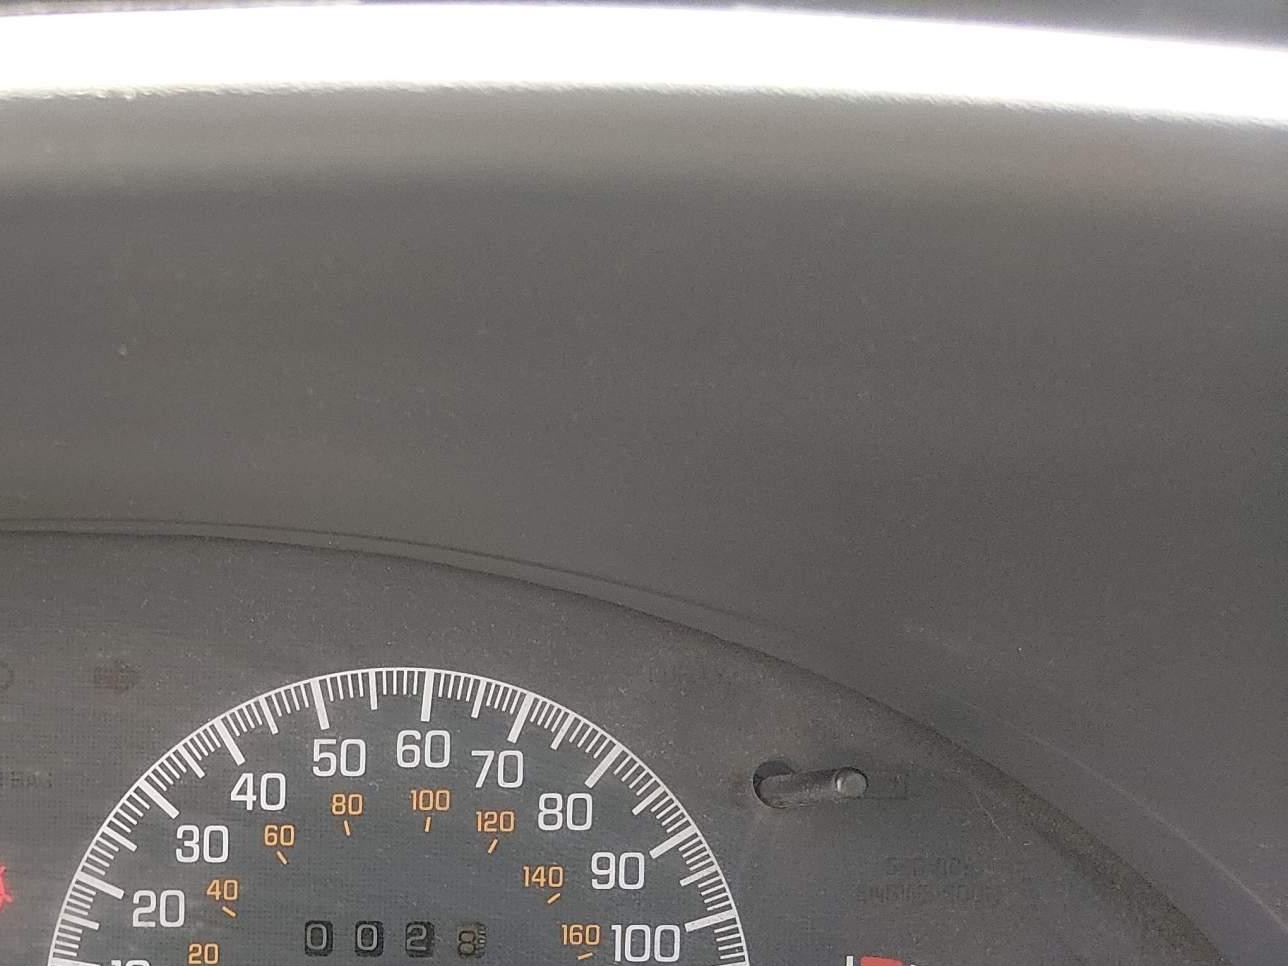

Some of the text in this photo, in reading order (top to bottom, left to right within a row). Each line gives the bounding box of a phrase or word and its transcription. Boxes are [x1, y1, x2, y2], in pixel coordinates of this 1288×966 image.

[312, 738, 366, 777] 50
[396, 729, 451, 768] 60
[471, 750, 524, 788] 70
[230, 772, 286, 811] 40
[331, 793, 363, 815] 80
[410, 789, 450, 811] 100
[476, 811, 515, 832] 120
[537, 792, 593, 831] 80
[175, 824, 229, 863] 30
[264, 824, 295, 846] 60
[523, 866, 563, 888] 140
[591, 851, 645, 890] 90
[132, 889, 185, 928] 20
[206, 879, 238, 901] 40
[561, 924, 601, 946] 160
[611, 924, 681, 963] 100
[188, 943, 219, 966] 20
